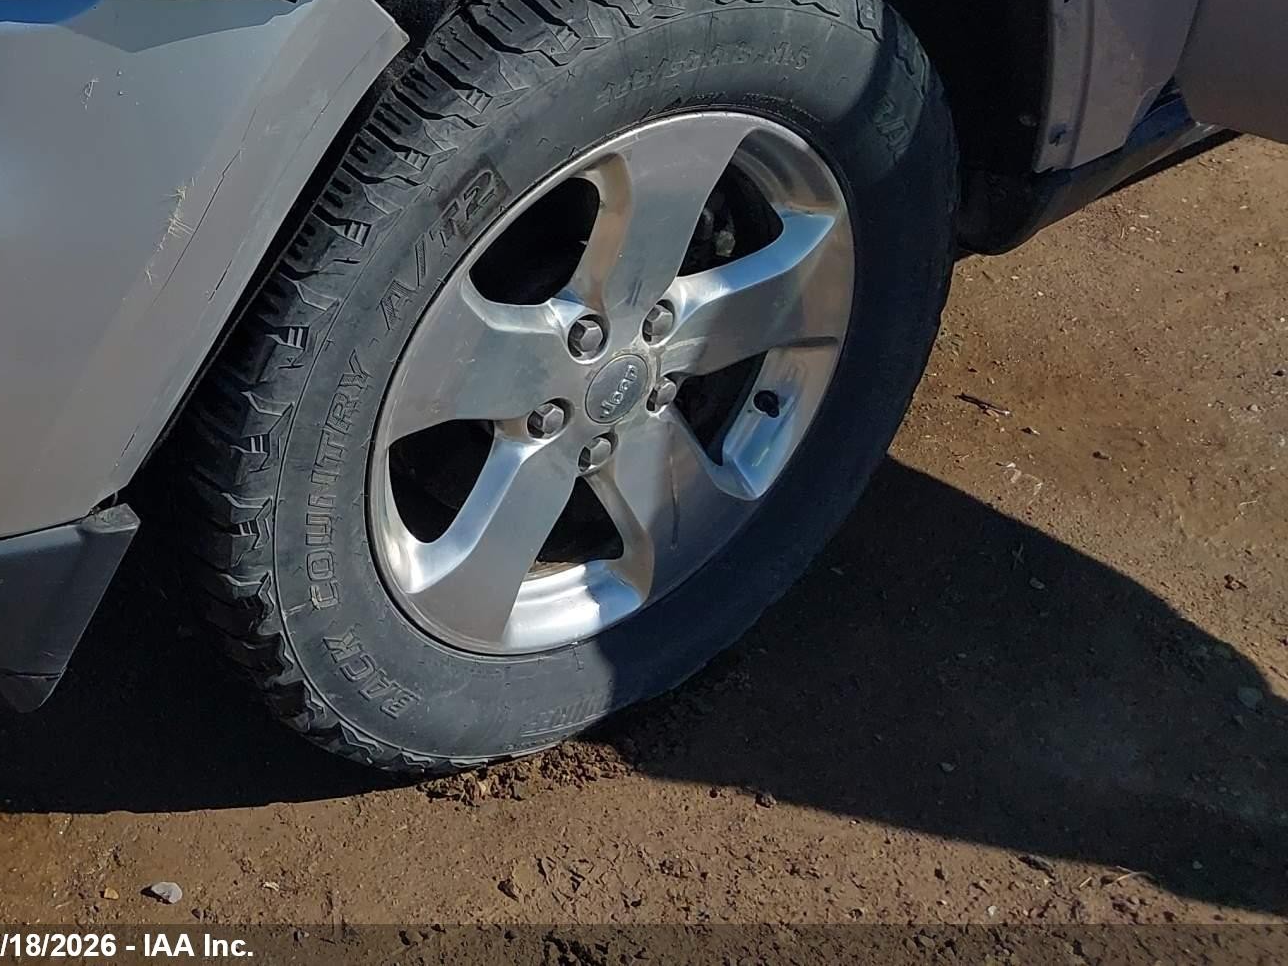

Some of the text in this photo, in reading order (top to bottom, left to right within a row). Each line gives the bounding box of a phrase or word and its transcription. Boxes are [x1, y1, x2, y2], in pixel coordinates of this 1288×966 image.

[305, 168, 497, 720] BACK COUNTRY A/T2
[599, 364, 639, 418] Jeep
